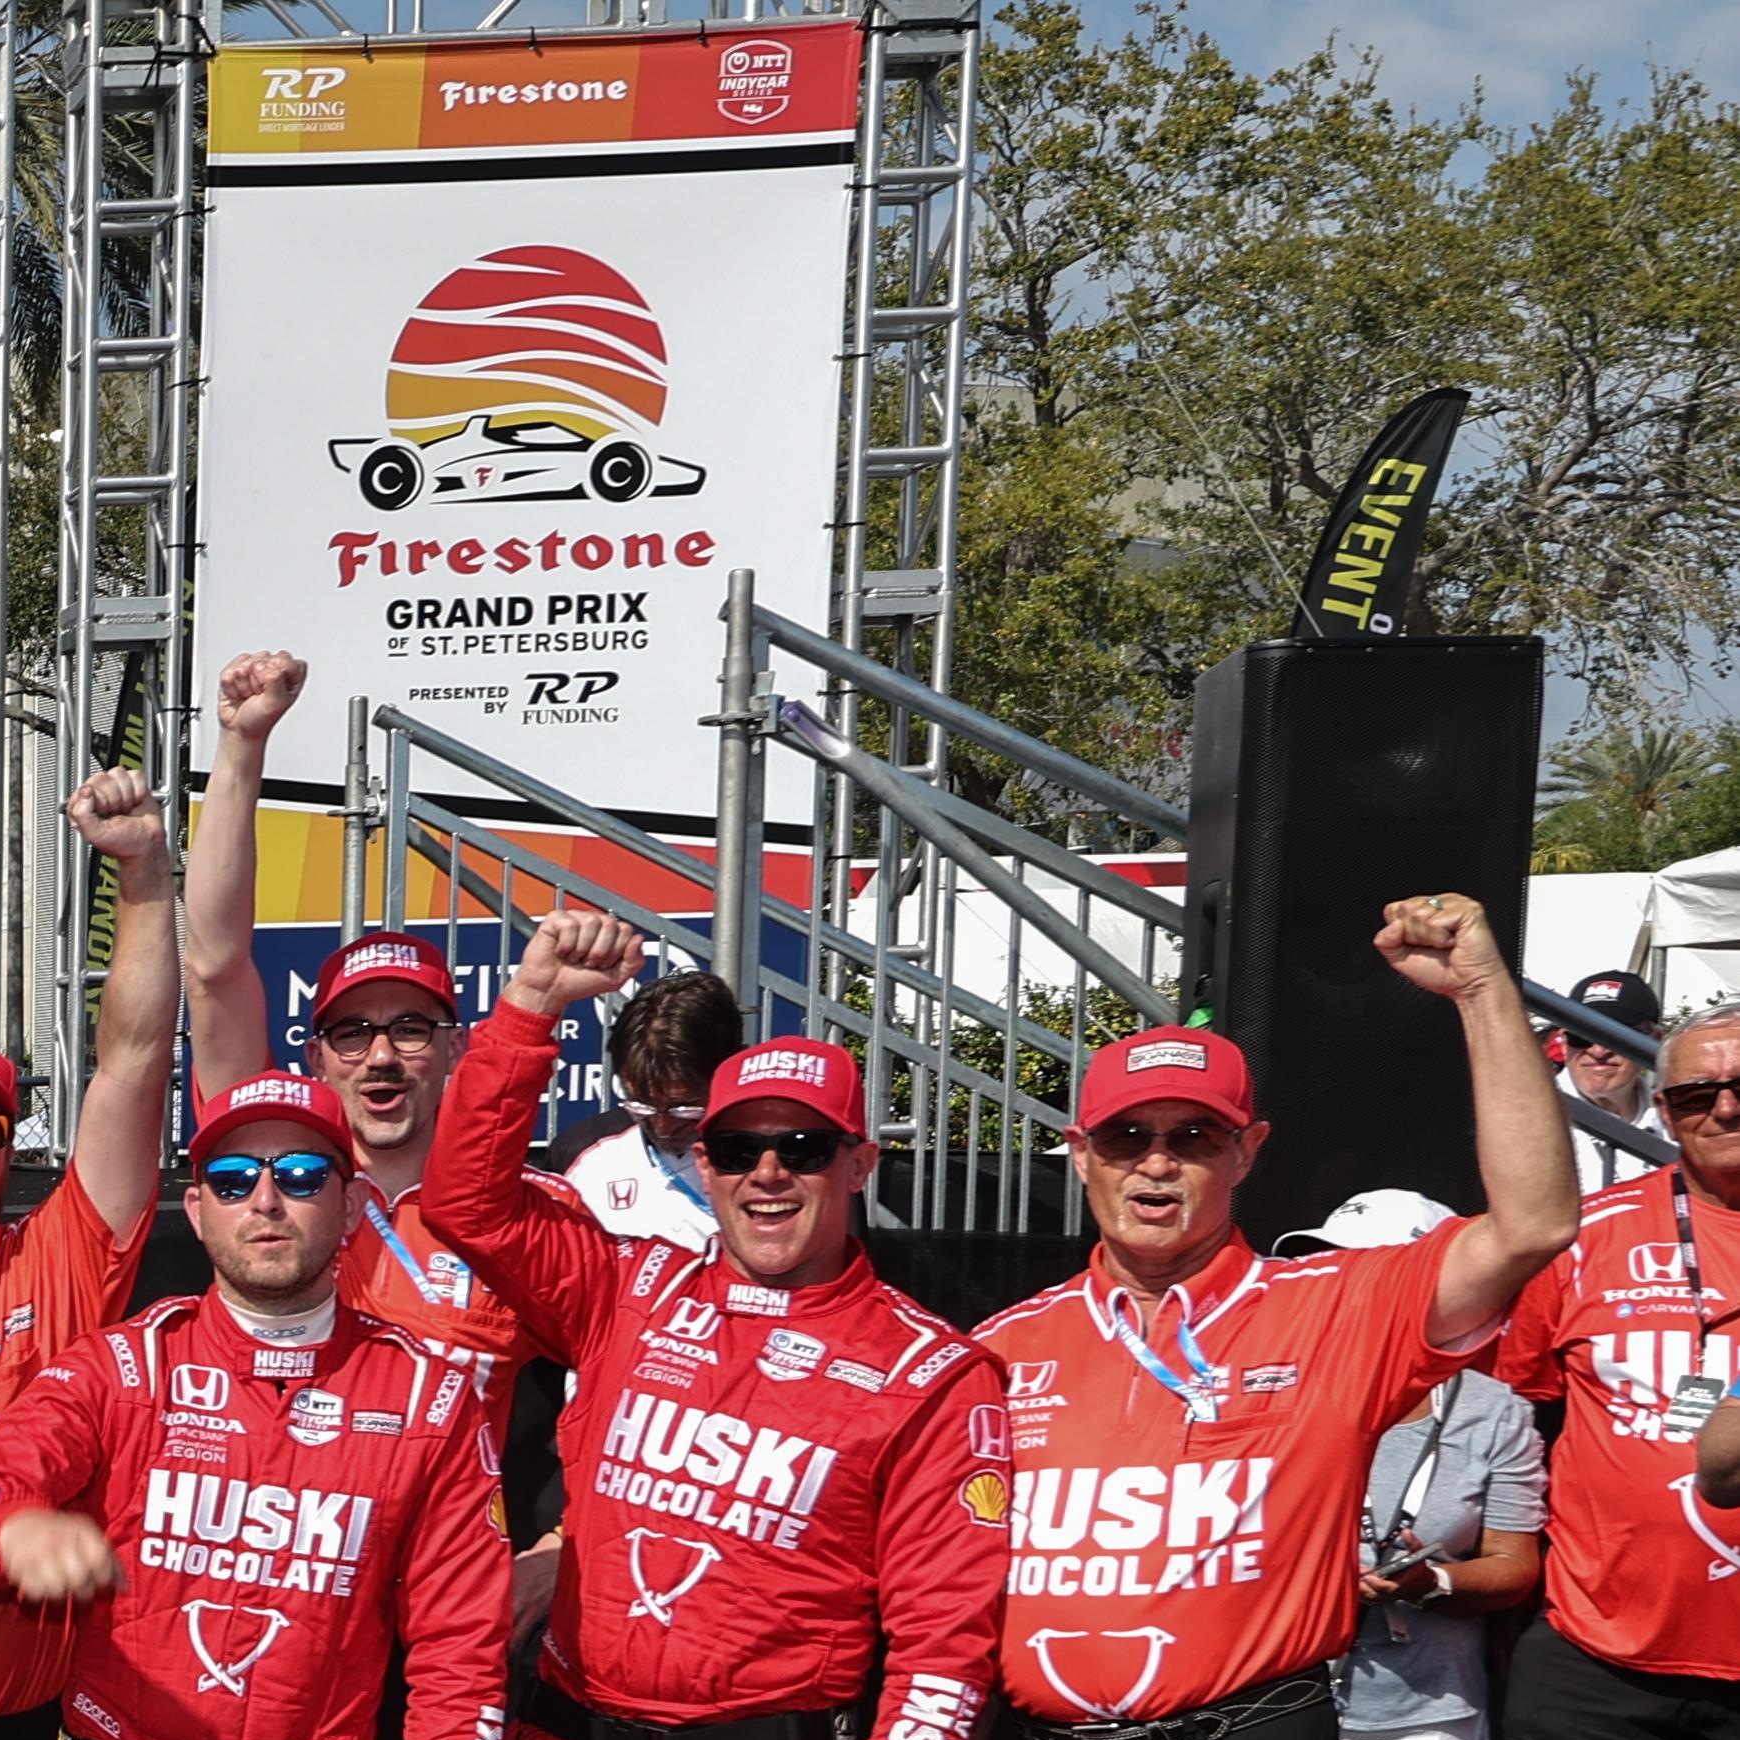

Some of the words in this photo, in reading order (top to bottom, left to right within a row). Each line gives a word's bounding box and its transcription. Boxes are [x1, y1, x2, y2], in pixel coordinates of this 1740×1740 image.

[752, 54, 786, 70] NTT
[260, 67, 348, 98] RP
[439, 79, 629, 111] Firestone
[719, 75, 791, 92] INDYCAR
[259, 100, 346, 118] FUNDING
[258, 123, 282, 132] DIRECT
[284, 122, 318, 132] MORTGAGE
[319, 121, 345, 131] LENDER
[328, 529, 716, 588] Firestone
[1322, 458, 1428, 632] EVENT
[386, 595, 533, 630] GRAND
[547, 592, 648, 626] PRIX
[387, 636, 411, 653] OF
[409, 686, 509, 703] PRESENTED
[522, 671, 620, 705] RP
[483, 700, 508, 714] BY
[522, 707, 619, 724] FUNDING
[344, 943, 419, 971] HUSKI
[740, 1051, 826, 1079] HUSKI
[230, 1079, 311, 1108] HUSKI
[727, 1283, 790, 1307] HUSKI
[253, 1350, 316, 1369] HUSKI
[160, 1409, 248, 1434] HONDA
[603, 1388, 839, 1516] HUSKI
[143, 1467, 374, 1562] HUSKI
[595, 1460, 809, 1551] CHOCOLATE
[139, 1536, 357, 1597] CHOCOLATE
